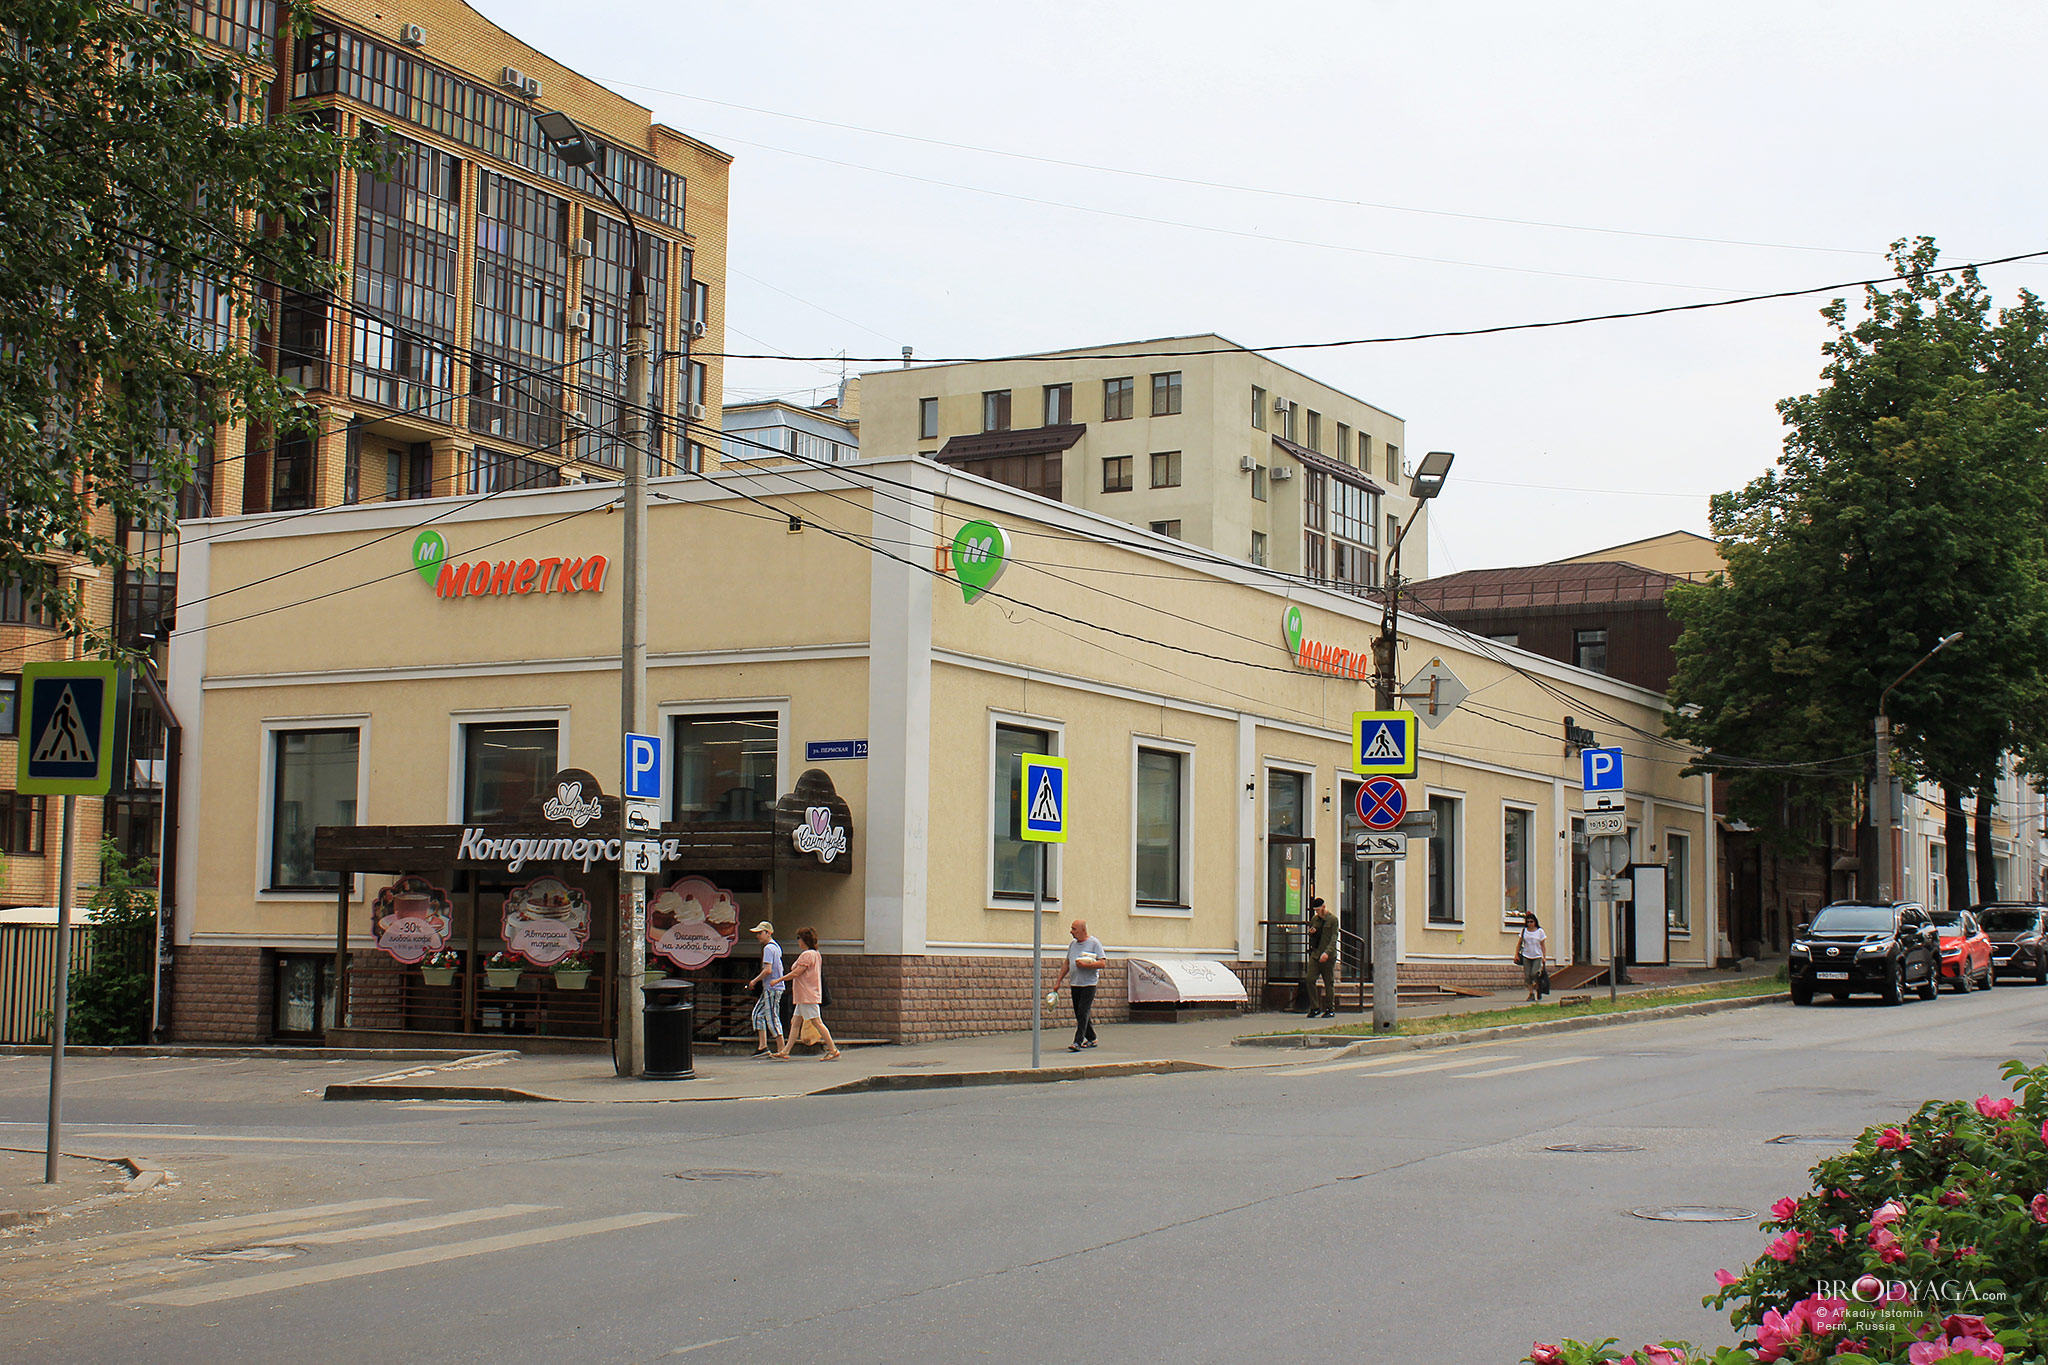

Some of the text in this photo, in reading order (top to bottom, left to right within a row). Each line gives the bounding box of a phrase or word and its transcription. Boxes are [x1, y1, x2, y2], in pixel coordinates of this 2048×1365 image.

[820, 746, 849, 754] ПЕРМСКАЯ
[856, 743, 868, 754] 22
[631, 739, 655, 792] P
[1591, 753, 1614, 786] P
[1608, 819, 1619, 828] 20
[457, 828, 682, 874] Кондитерся
[674, 931, 711, 942] Десерты
[675, 941, 701, 950] любой
[702, 942, 721, 952] вкус
